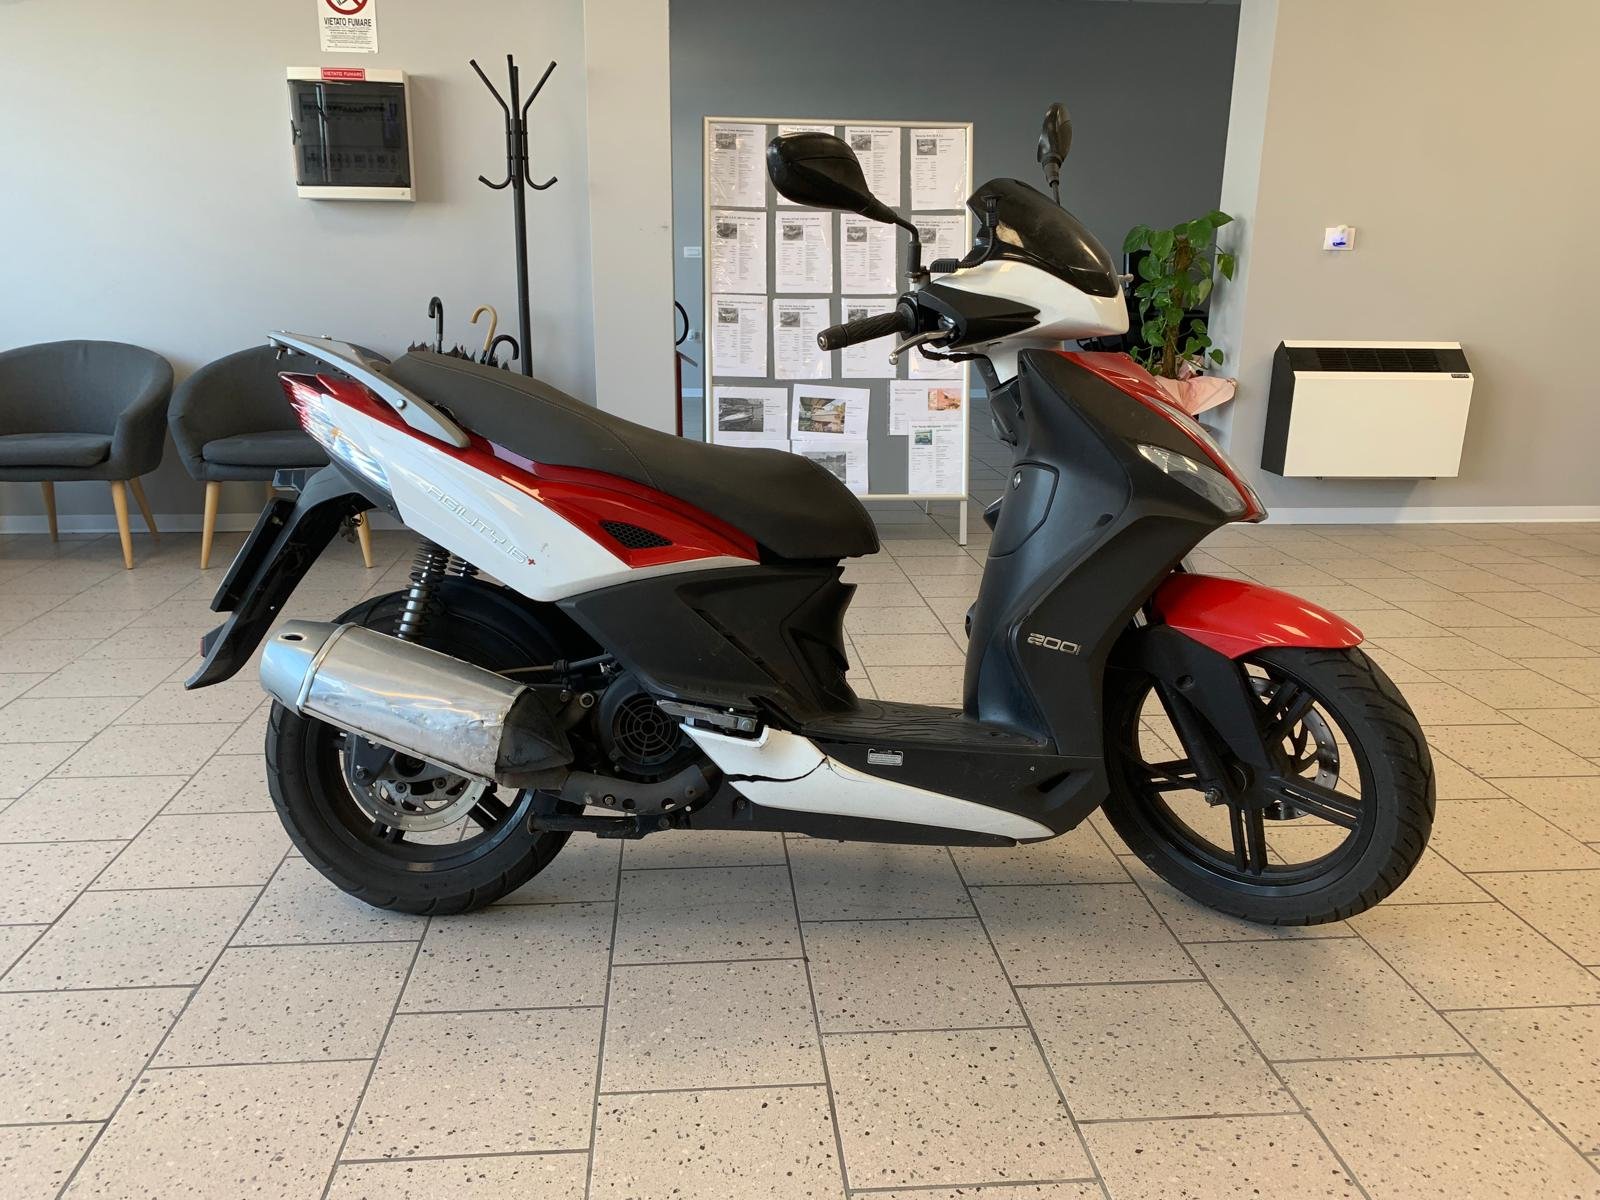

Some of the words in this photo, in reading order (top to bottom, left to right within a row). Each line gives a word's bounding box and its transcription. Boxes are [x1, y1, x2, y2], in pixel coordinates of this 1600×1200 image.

[324, 17, 346, 26] VIETATO
[348, 18, 372, 27] FUMARE
[427, 486, 507, 545] AGILITY
